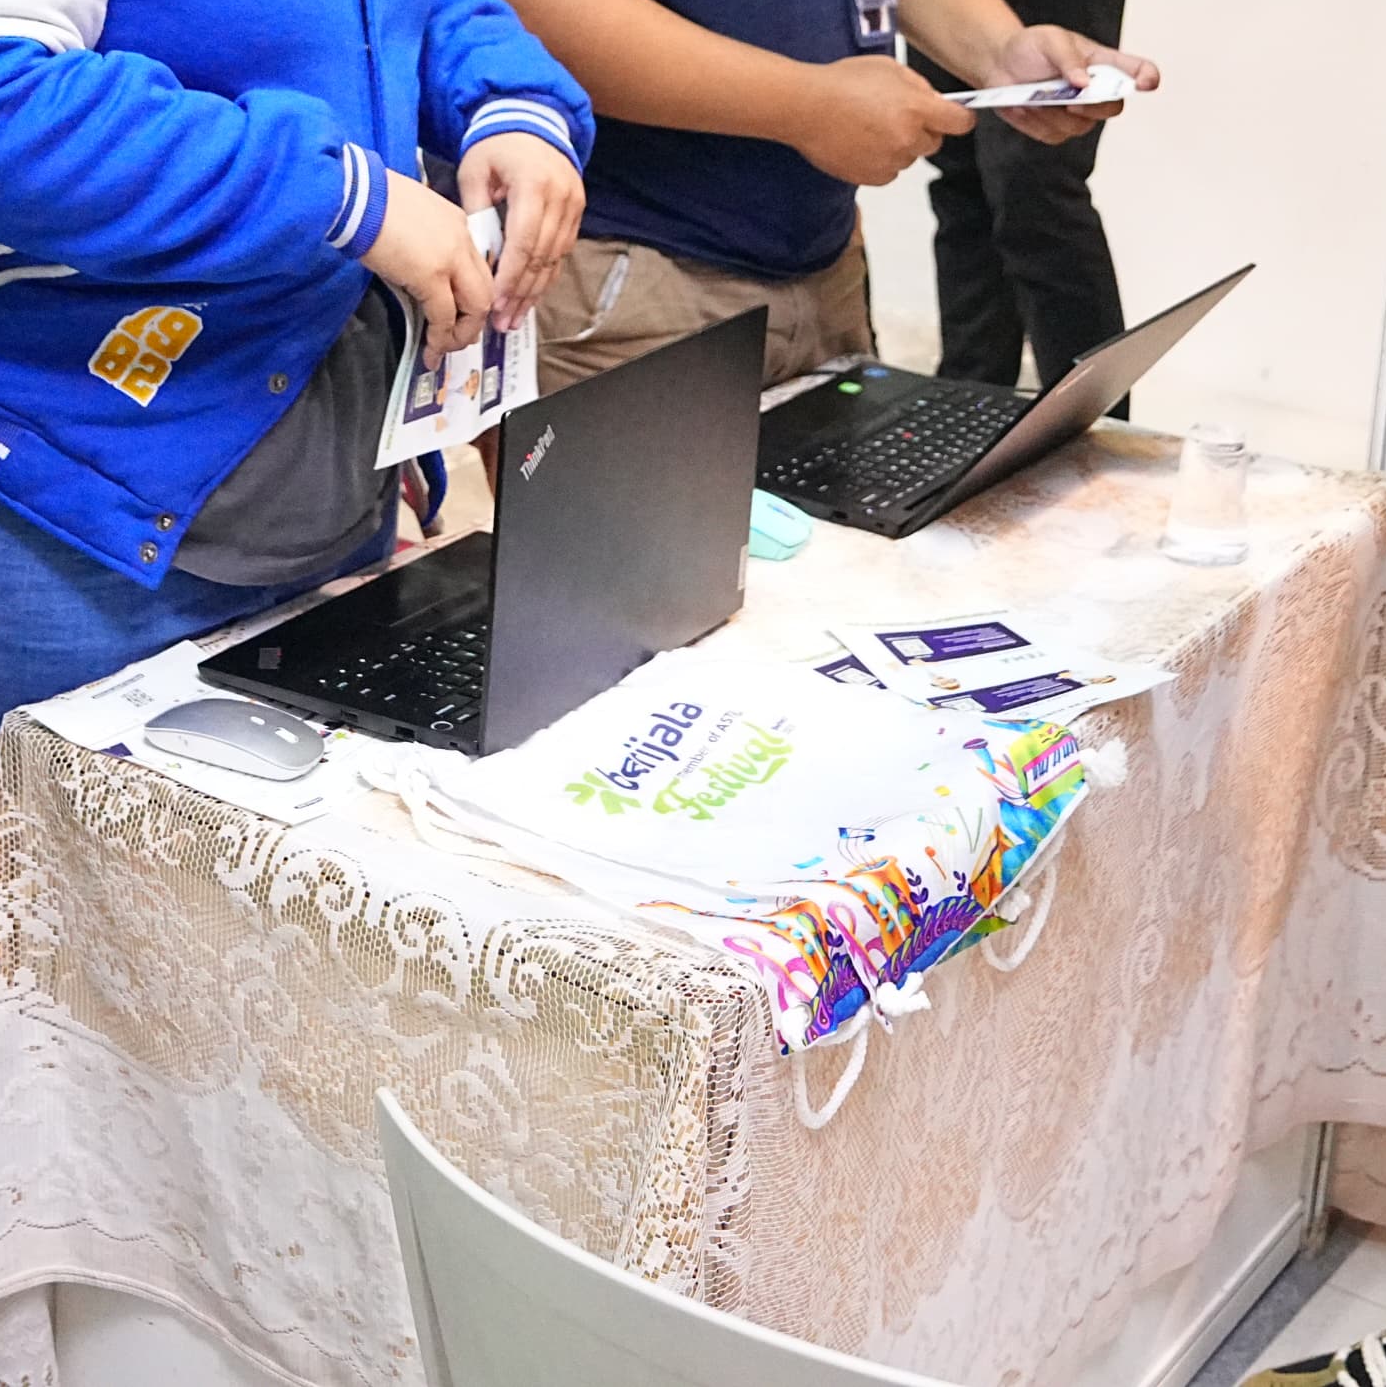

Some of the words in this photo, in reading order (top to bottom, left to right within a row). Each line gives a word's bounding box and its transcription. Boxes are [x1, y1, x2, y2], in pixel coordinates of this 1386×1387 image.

[519, 423, 555, 481] ThinkPad
[595, 702, 704, 791] berijala
[652, 720, 794, 820] Festival
